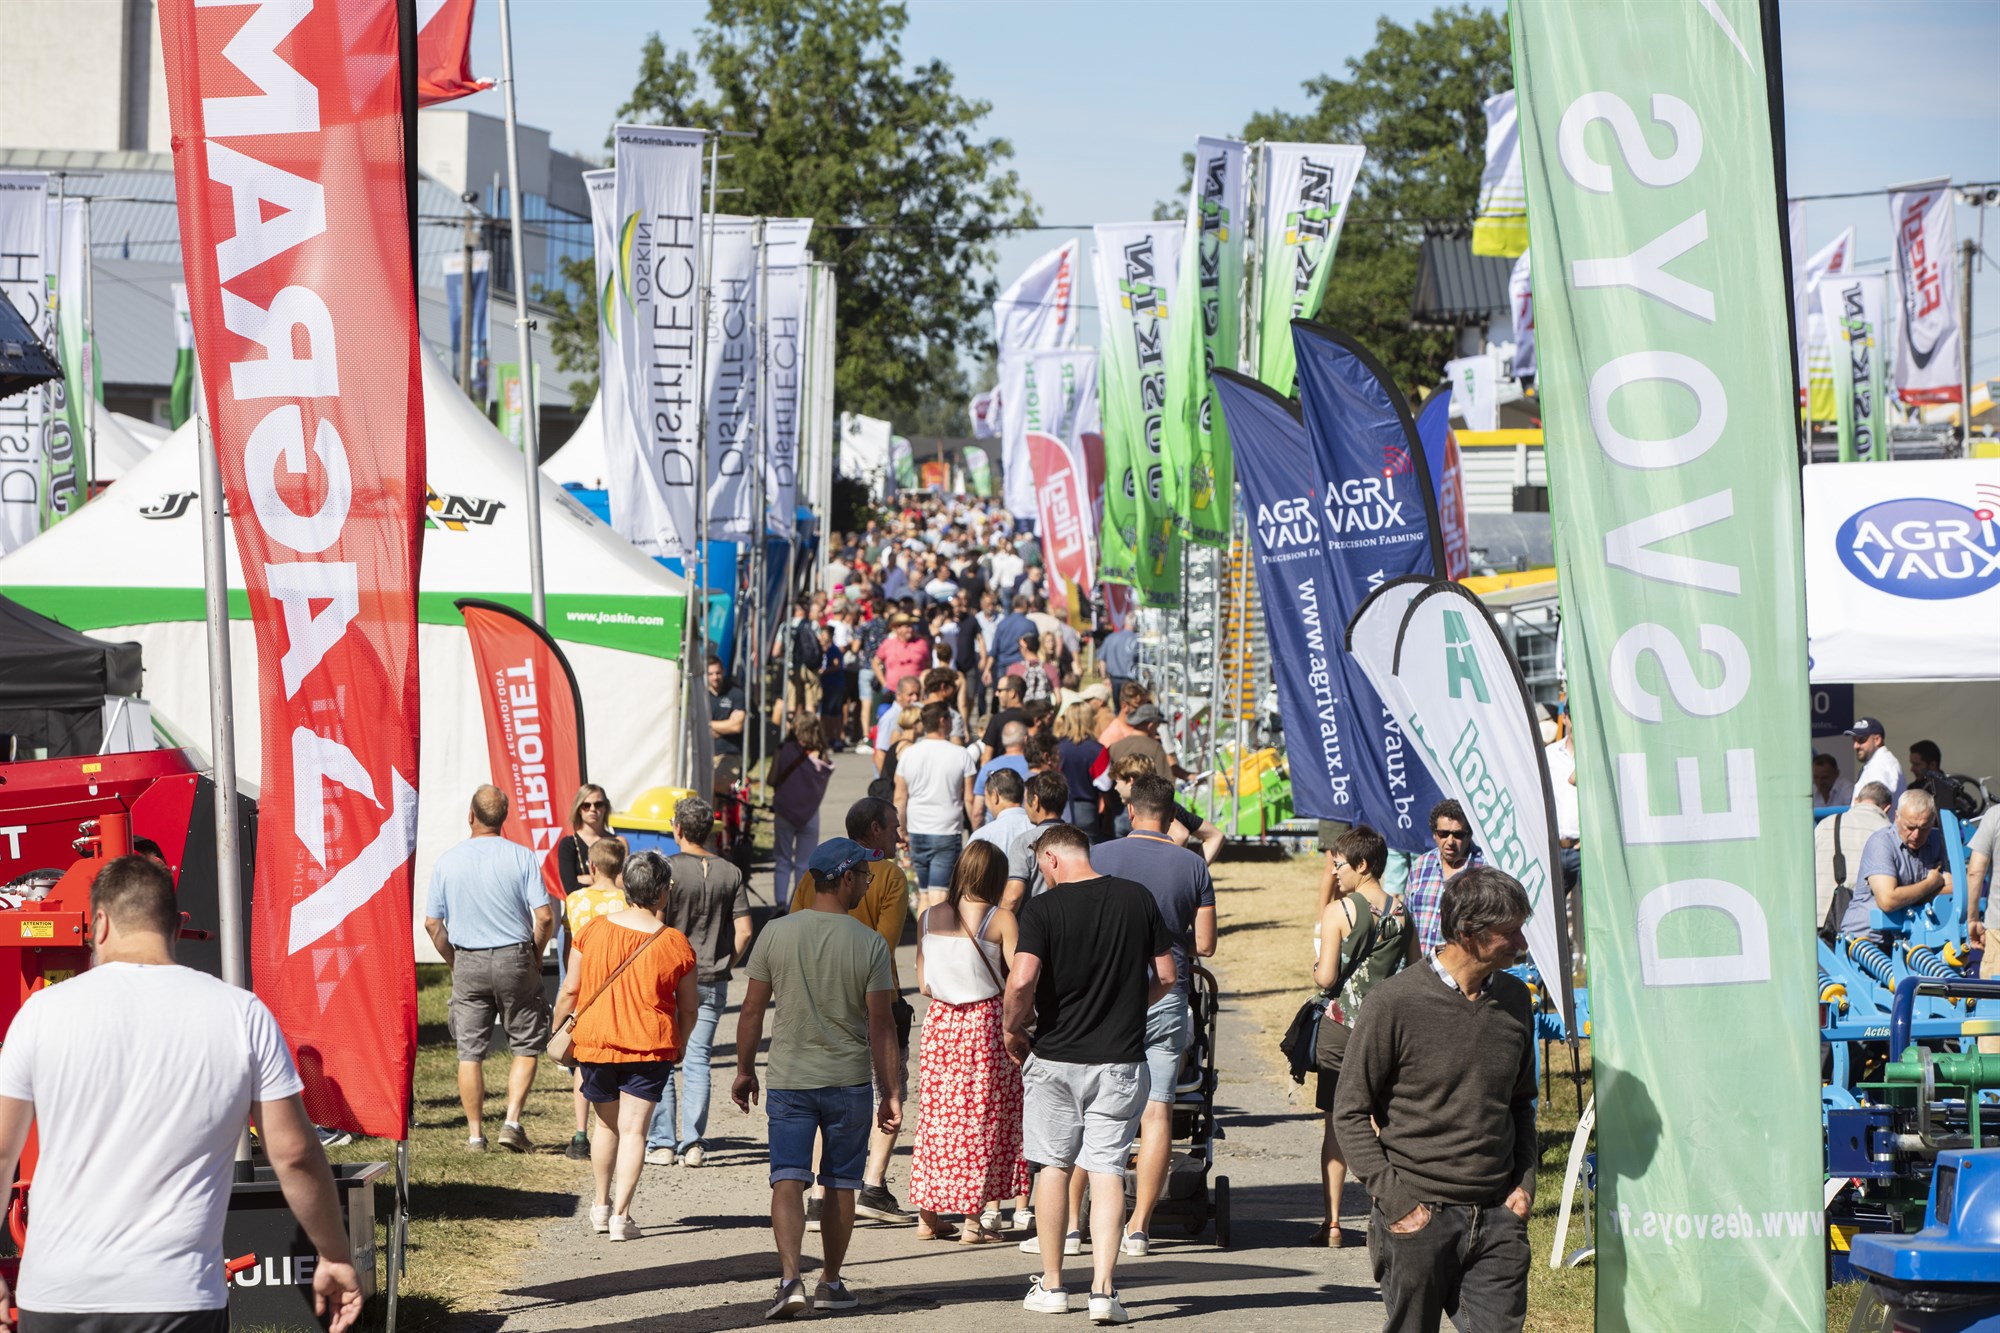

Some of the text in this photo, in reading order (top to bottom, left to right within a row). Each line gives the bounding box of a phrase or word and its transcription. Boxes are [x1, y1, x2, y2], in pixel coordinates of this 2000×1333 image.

[1324, 476, 1395, 506] AGRI
[1257, 497, 1318, 527] AGR
[1325, 502, 1407, 533] VAUX
[1852, 518, 1997, 551] AGRI
[566, 610, 664, 626] www.joskin.com
[1298, 577, 1350, 806] www.agrivaux.be
[225, 1255, 318, 1288] OLIE
